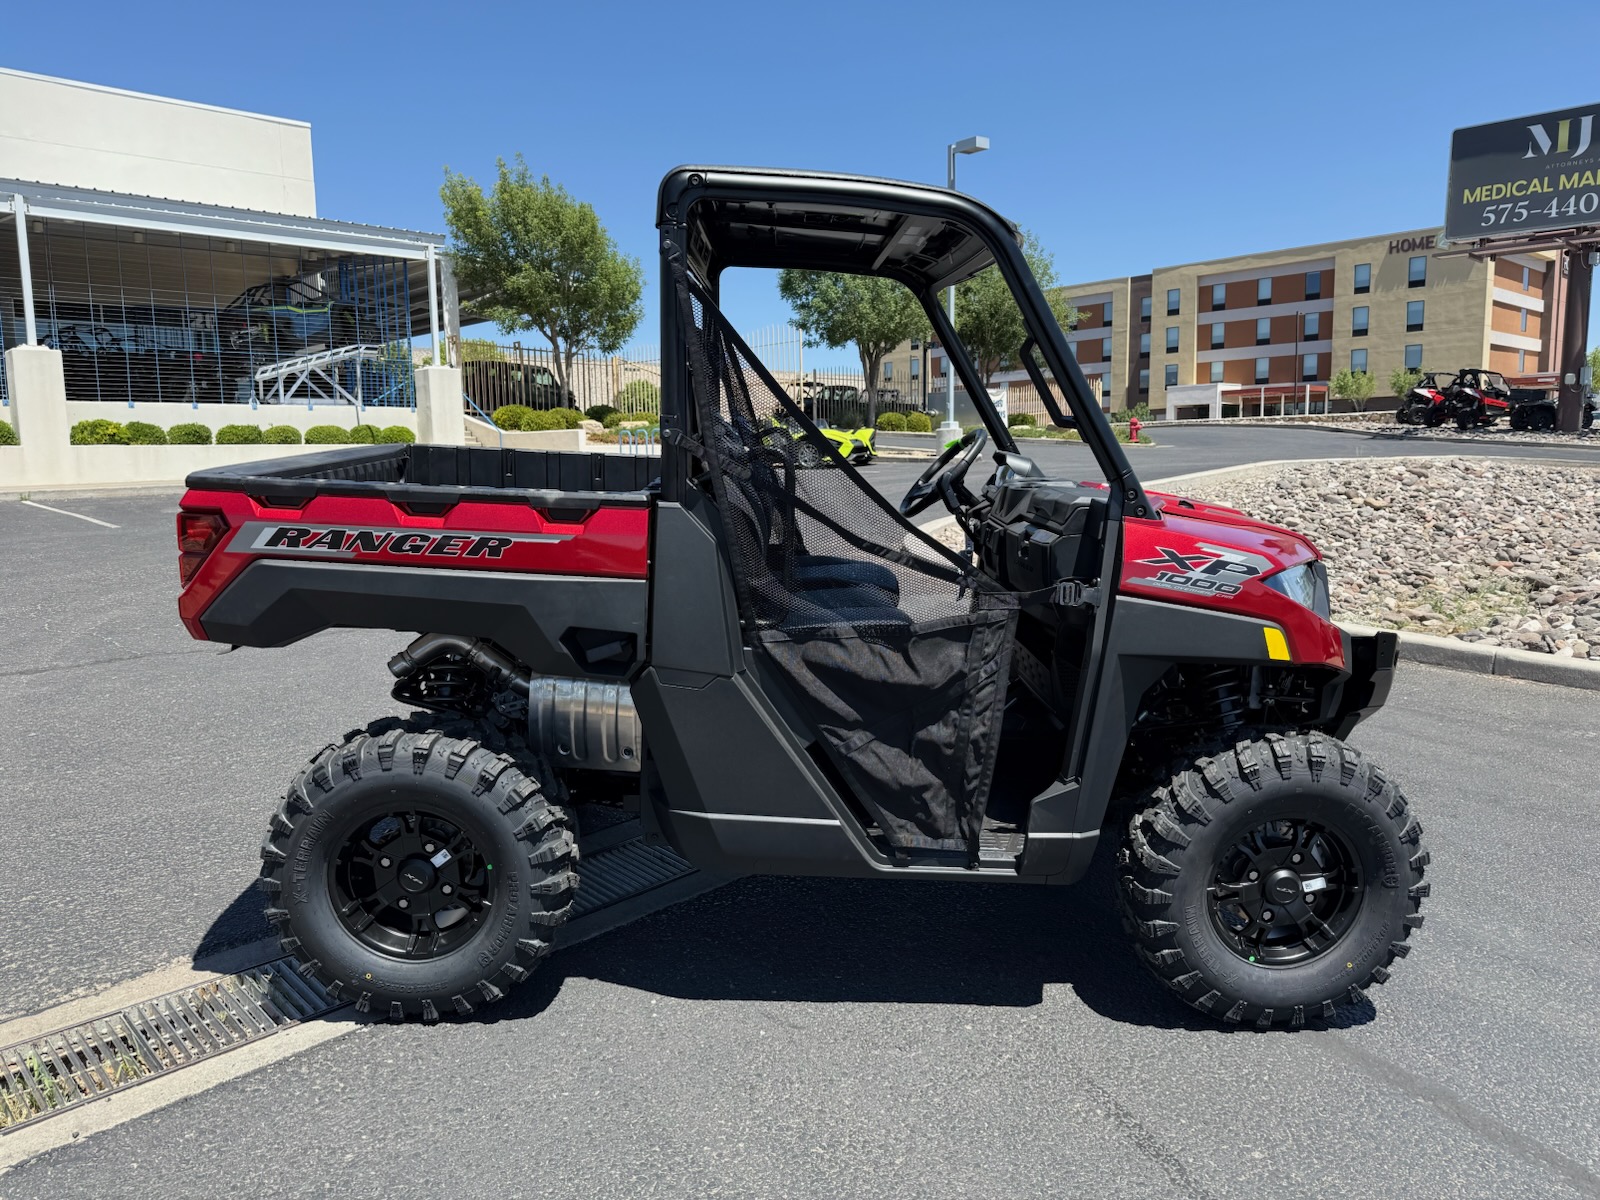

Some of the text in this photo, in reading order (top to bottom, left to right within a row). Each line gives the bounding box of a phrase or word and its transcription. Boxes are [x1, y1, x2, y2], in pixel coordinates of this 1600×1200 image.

[1545, 158, 1594, 170] ATTORNEYS
[1462, 176, 1554, 205] MEDICAL
[1480, 192, 1599, 227] 575-440
[1388, 235, 1436, 255] HOME
[263, 525, 513, 559] RANGER
[1133, 545, 1262, 577] XP
[1155, 571, 1243, 596] 1000
[292, 808, 335, 905] X-TERRAIN
[1185, 904, 1239, 988] X-TERRAIN
